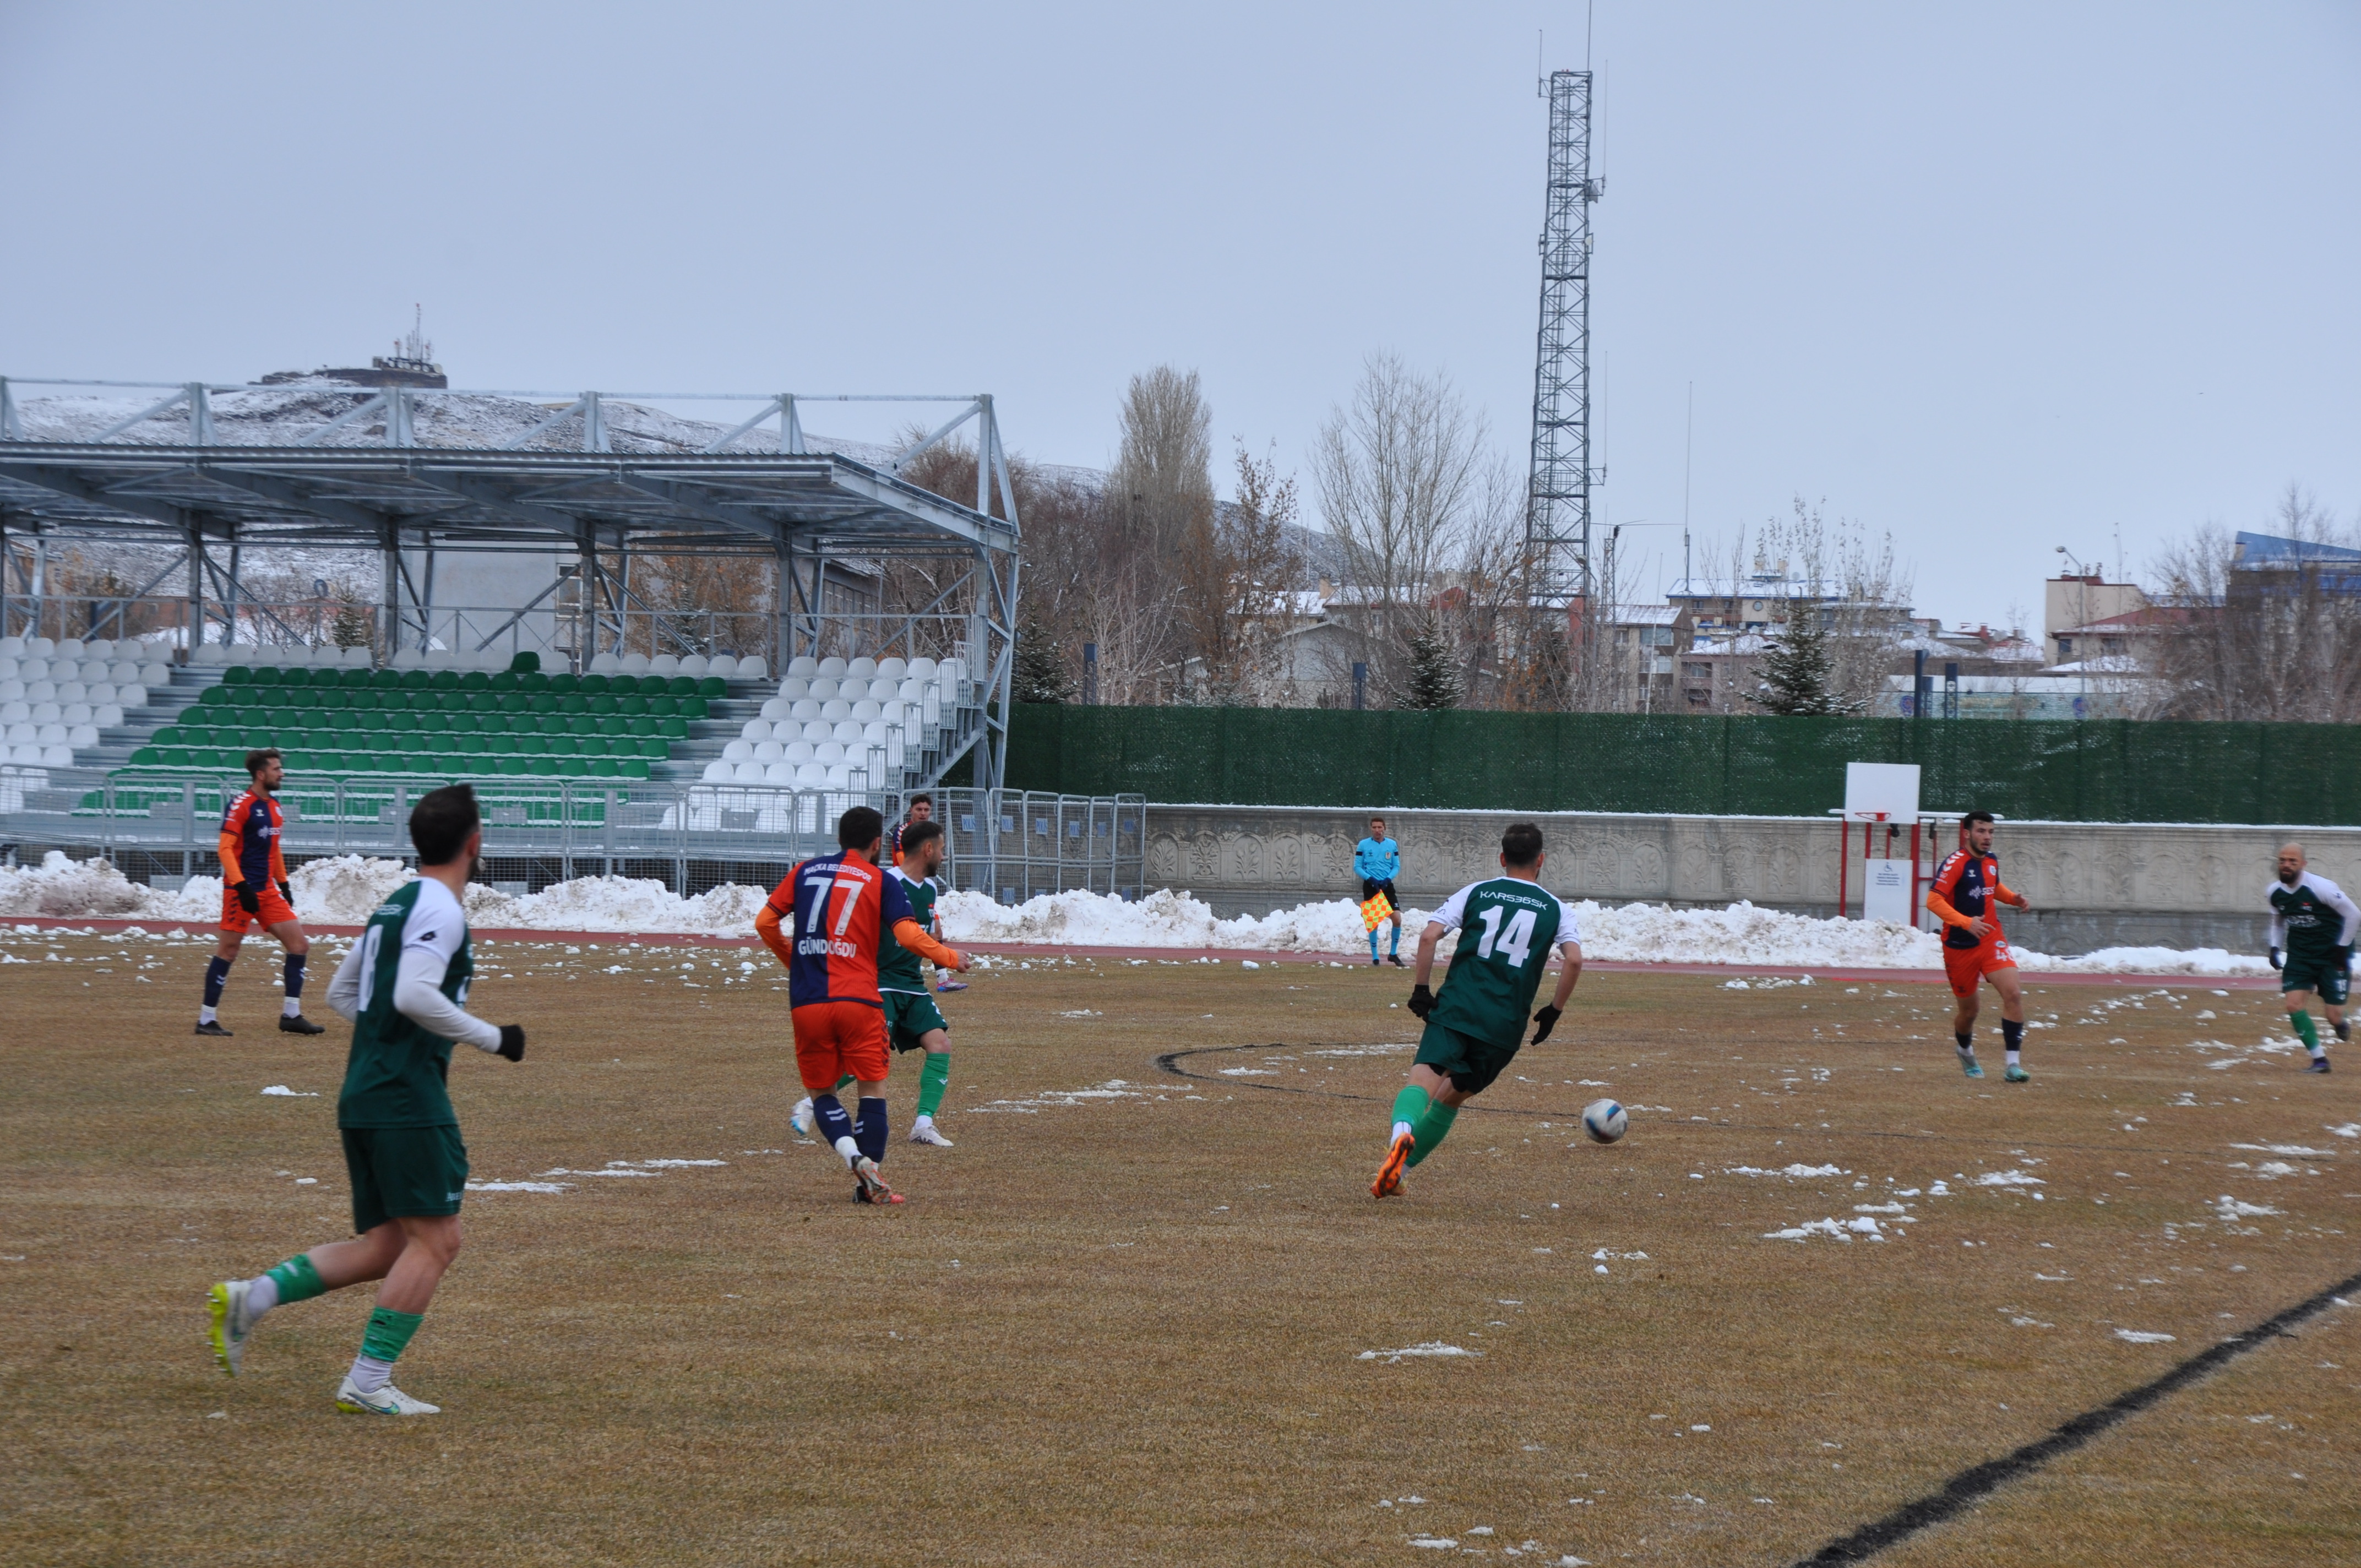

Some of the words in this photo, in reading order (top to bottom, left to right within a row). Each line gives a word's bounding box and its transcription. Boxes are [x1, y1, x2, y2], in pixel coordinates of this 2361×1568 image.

[804, 876, 865, 936] 77
[1479, 891, 1548, 911] KARS36SK
[798, 936, 857, 959] GÜNDOĞDU
[1477, 905, 1537, 968] 14
